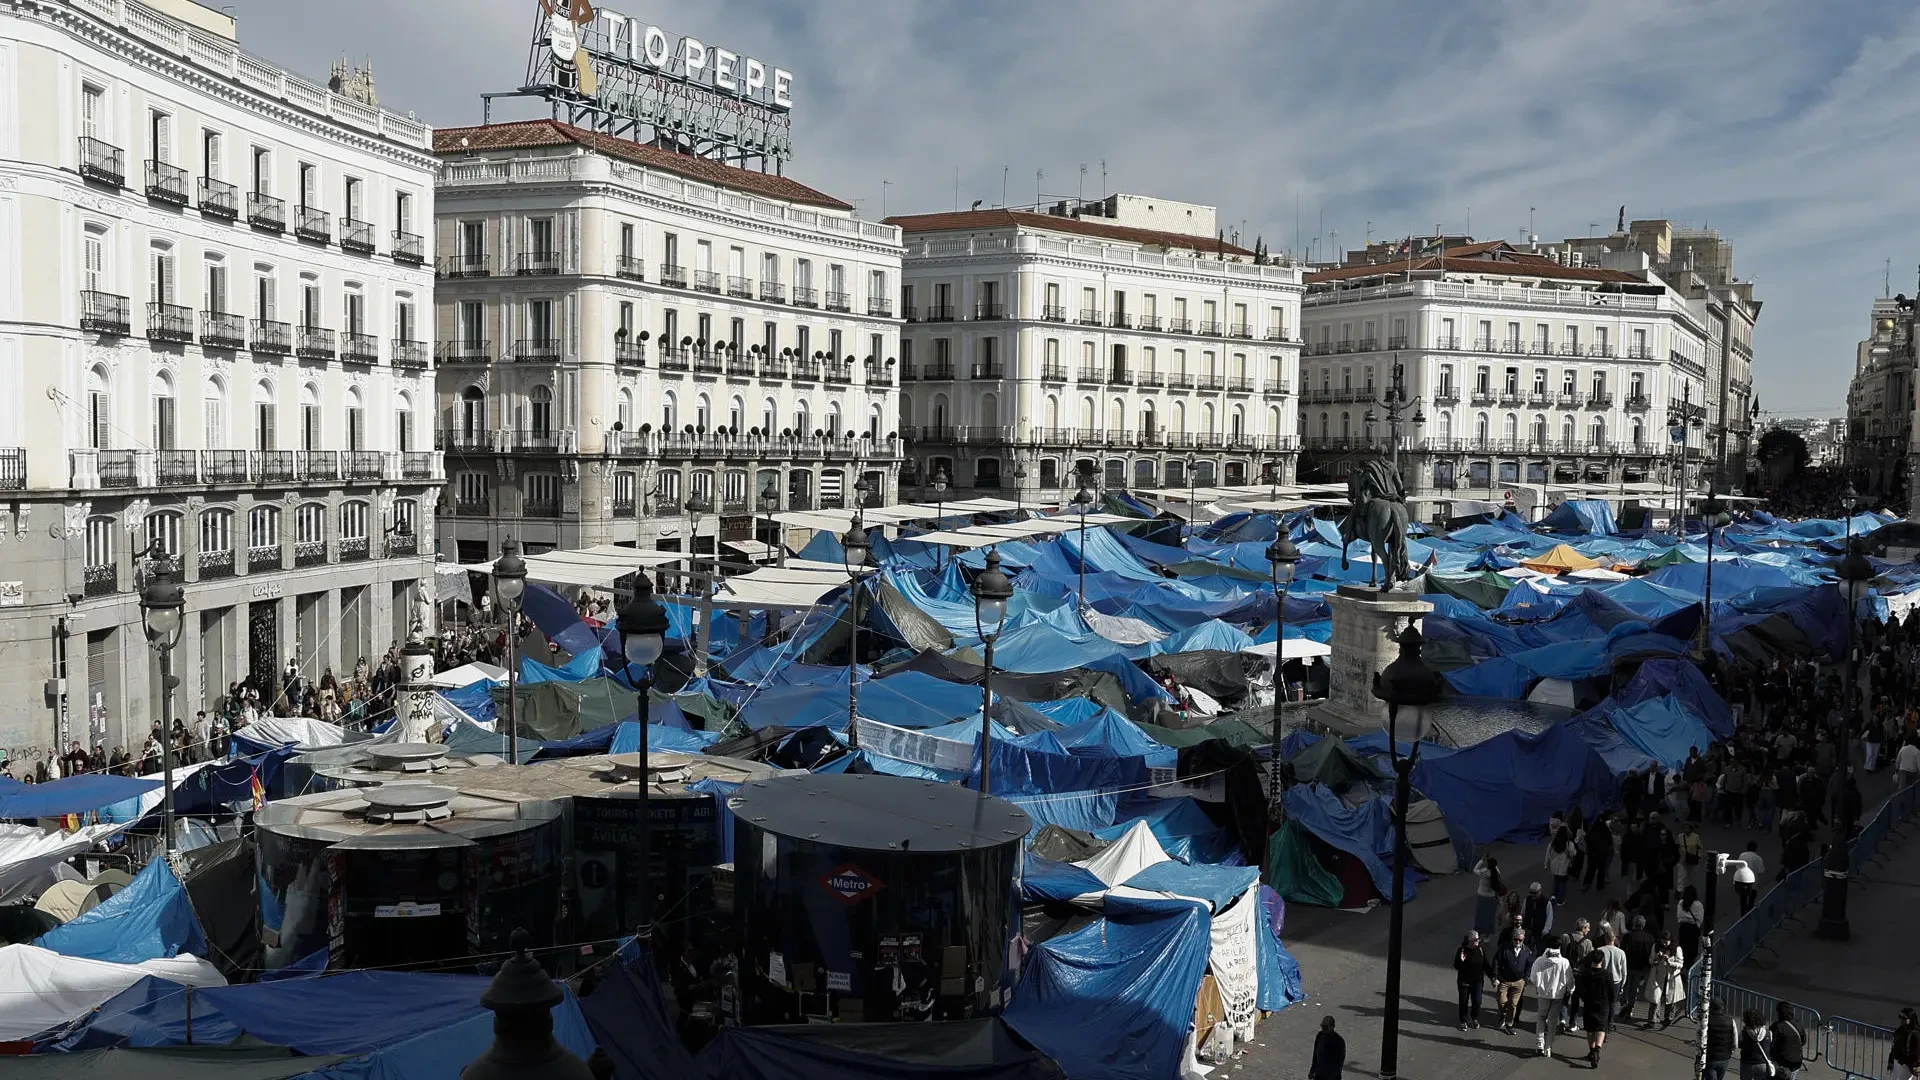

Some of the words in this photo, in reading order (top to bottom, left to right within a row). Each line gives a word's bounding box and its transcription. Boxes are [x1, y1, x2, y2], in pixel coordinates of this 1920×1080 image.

[600, 9, 669, 68] TIO
[684, 36, 793, 109] PEPE
[597, 64, 619, 81] SOL
[833, 877, 866, 891] Metro
